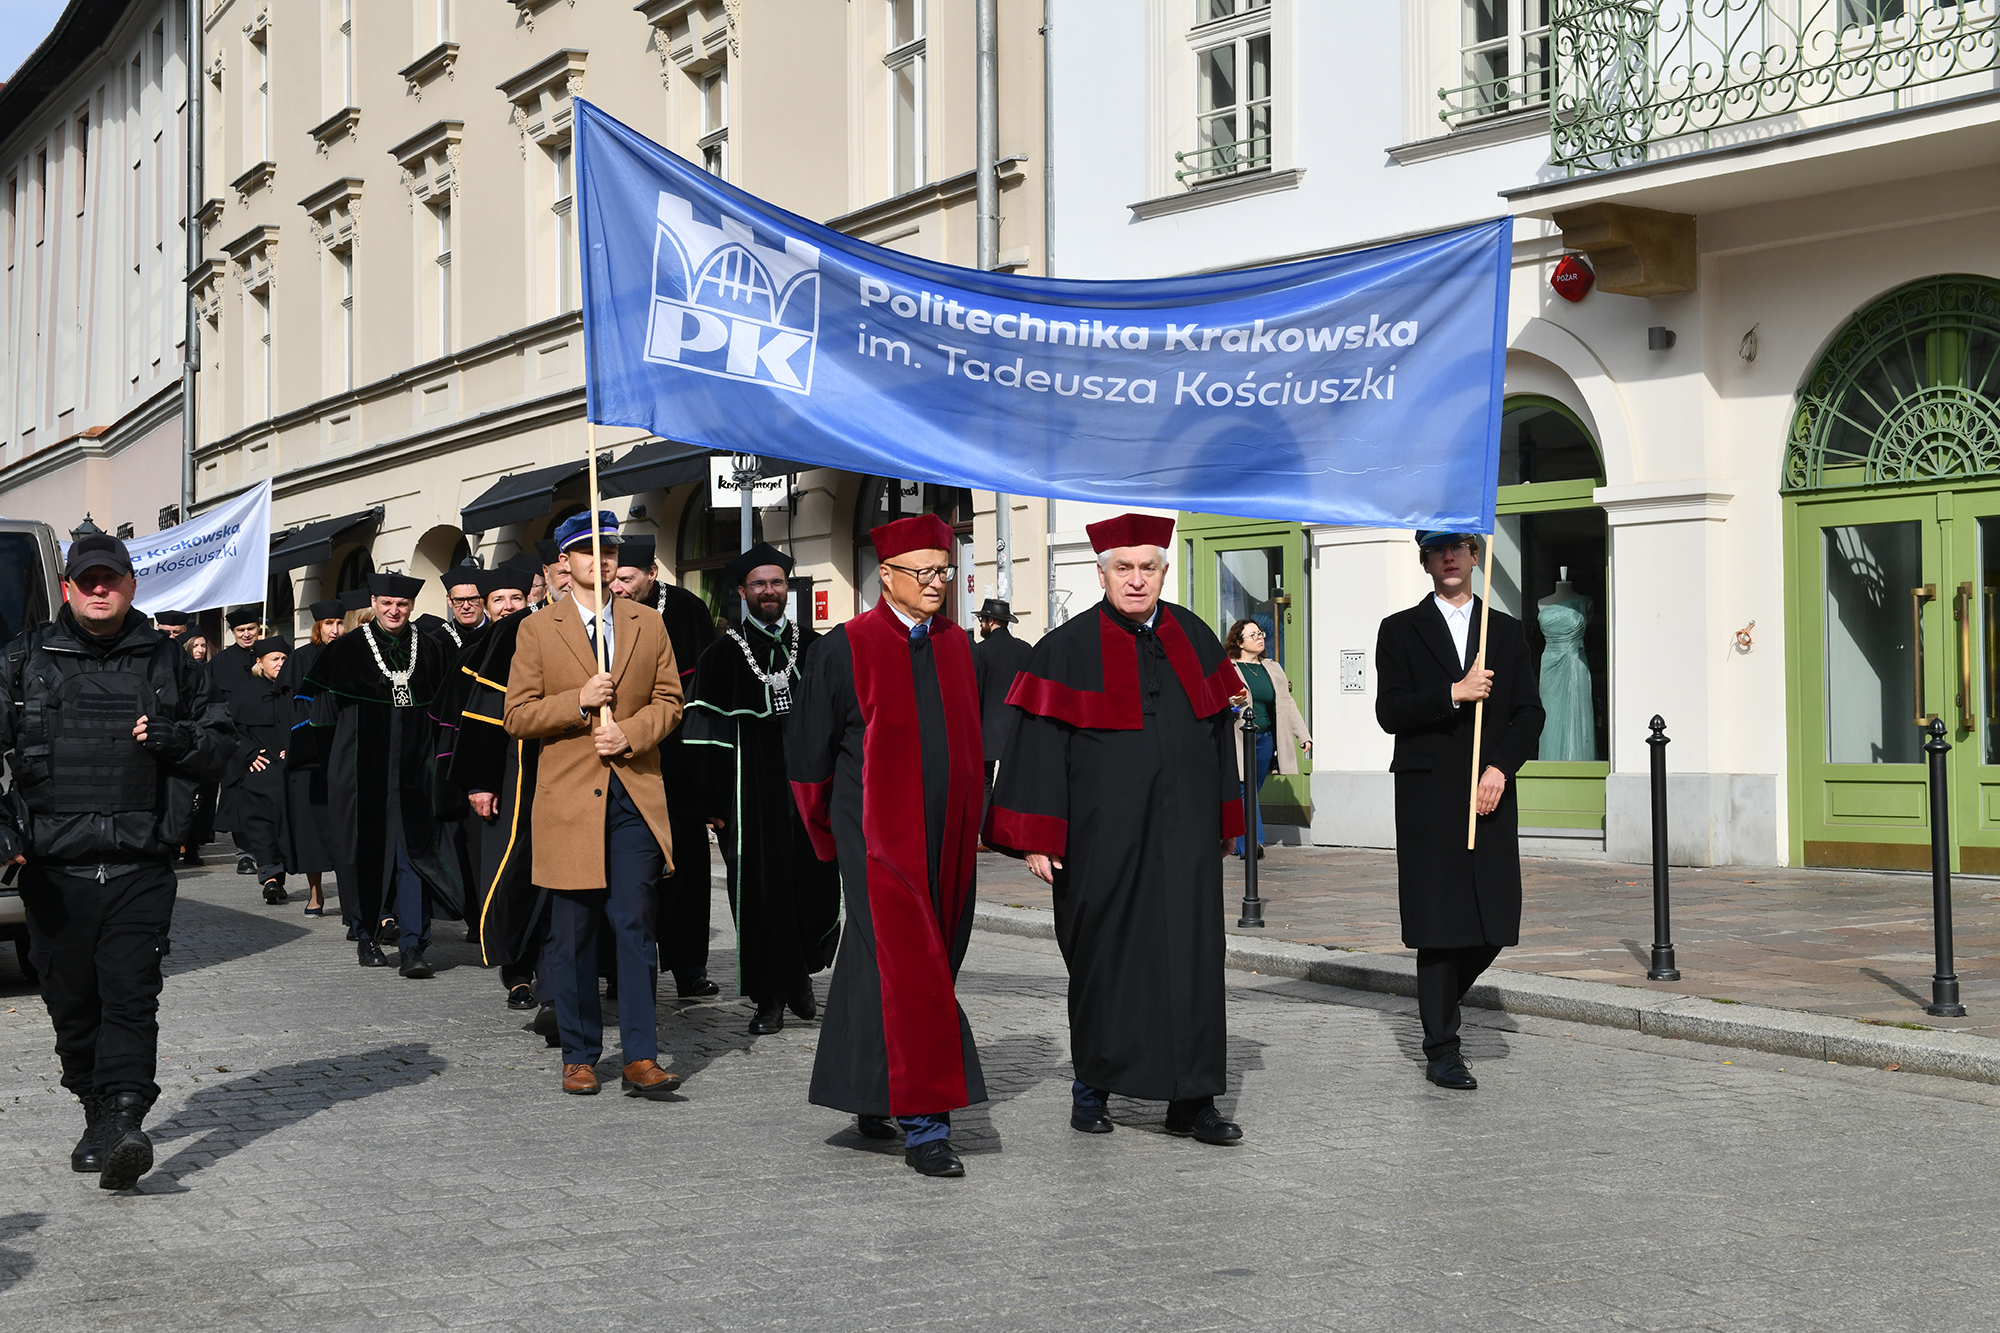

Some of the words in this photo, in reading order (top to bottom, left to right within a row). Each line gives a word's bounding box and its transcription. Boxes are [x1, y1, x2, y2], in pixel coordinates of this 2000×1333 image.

[1556, 272, 1578, 283] POŻAR
[859, 276, 1150, 350] Politechnika
[1164, 314, 1419, 353] Krakowska
[650, 301, 811, 389] PK
[858, 323, 922, 369] im.
[937, 344, 1158, 404] Tadeusza
[1174, 364, 1397, 408] Kościuszki
[147, 523, 241, 559] Krakowska
[156, 542, 237, 574] Kościuszki
